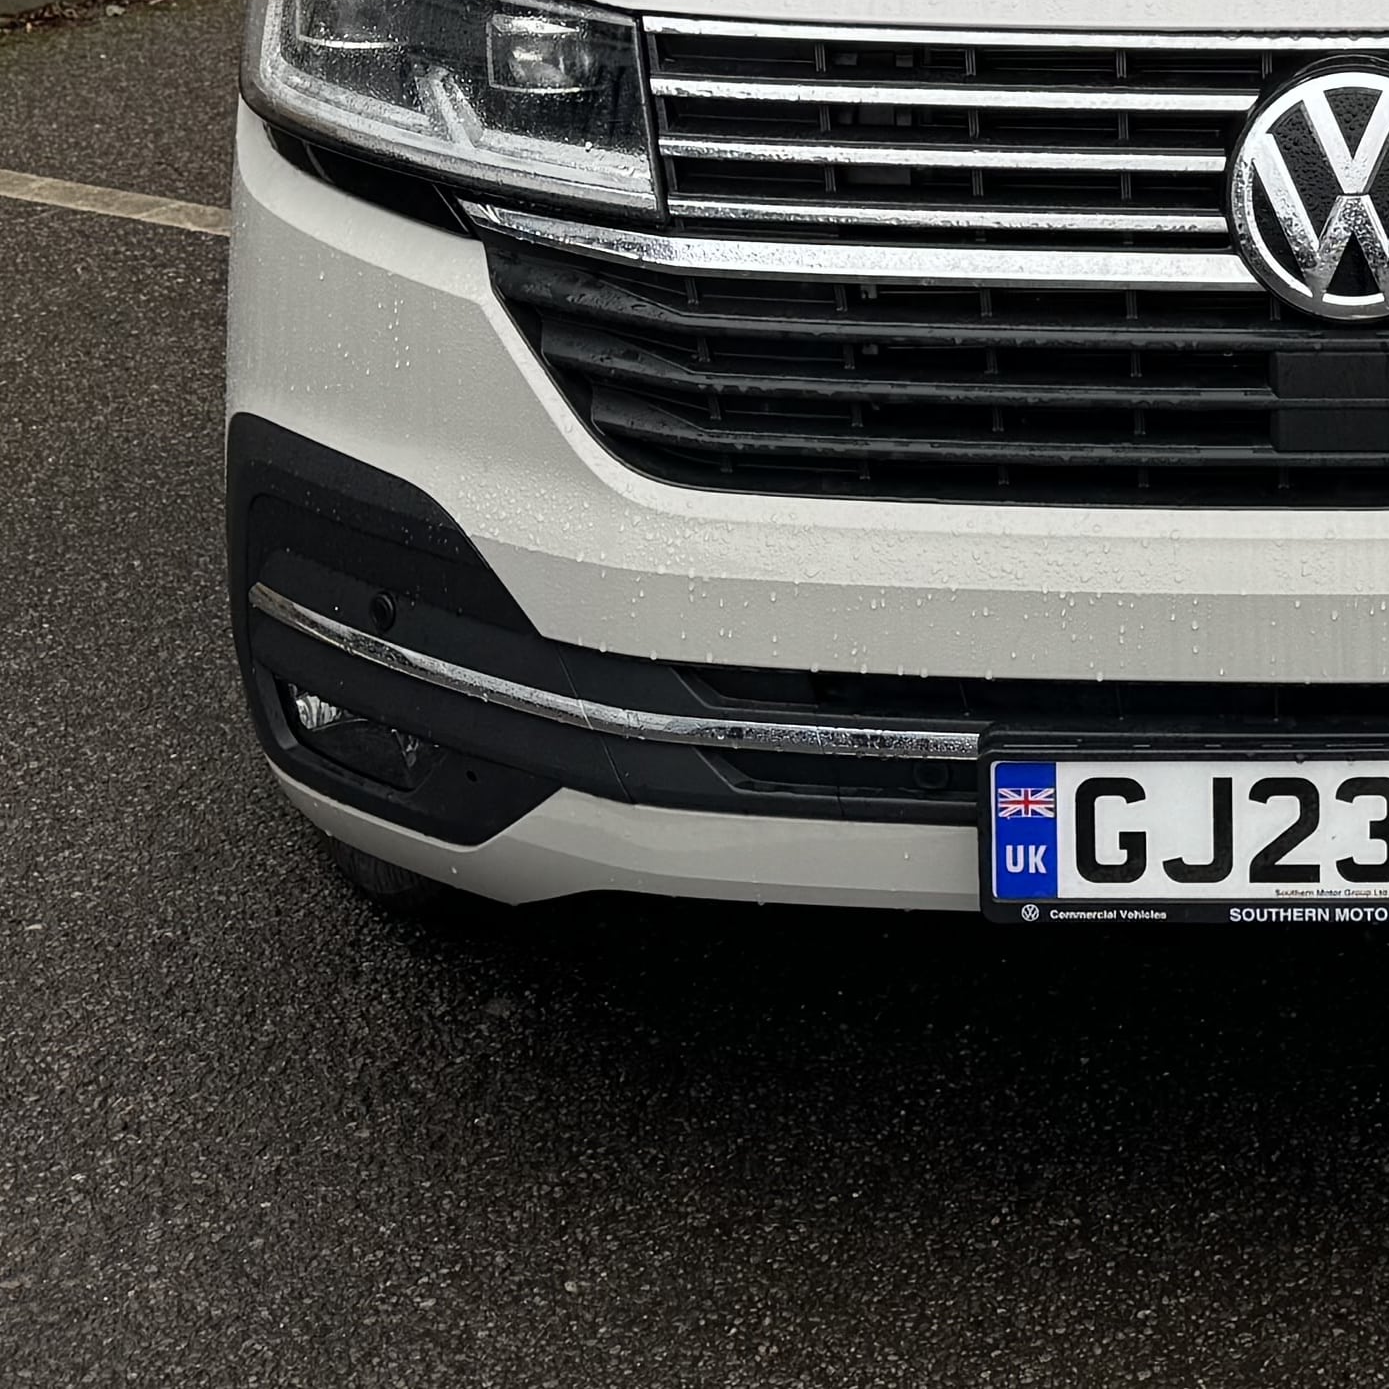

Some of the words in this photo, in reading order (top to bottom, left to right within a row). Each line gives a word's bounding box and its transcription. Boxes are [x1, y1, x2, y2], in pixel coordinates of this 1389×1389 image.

[1005, 844, 1047, 874] UK
[1275, 888, 1315, 897] Southern
[1316, 888, 1342, 897] Motor
[1344, 888, 1370, 898] Group
[1049, 909, 1117, 920] Commercial
[1119, 909, 1167, 920] Vehicles
[1229, 907, 1330, 922] SOUTHERN
